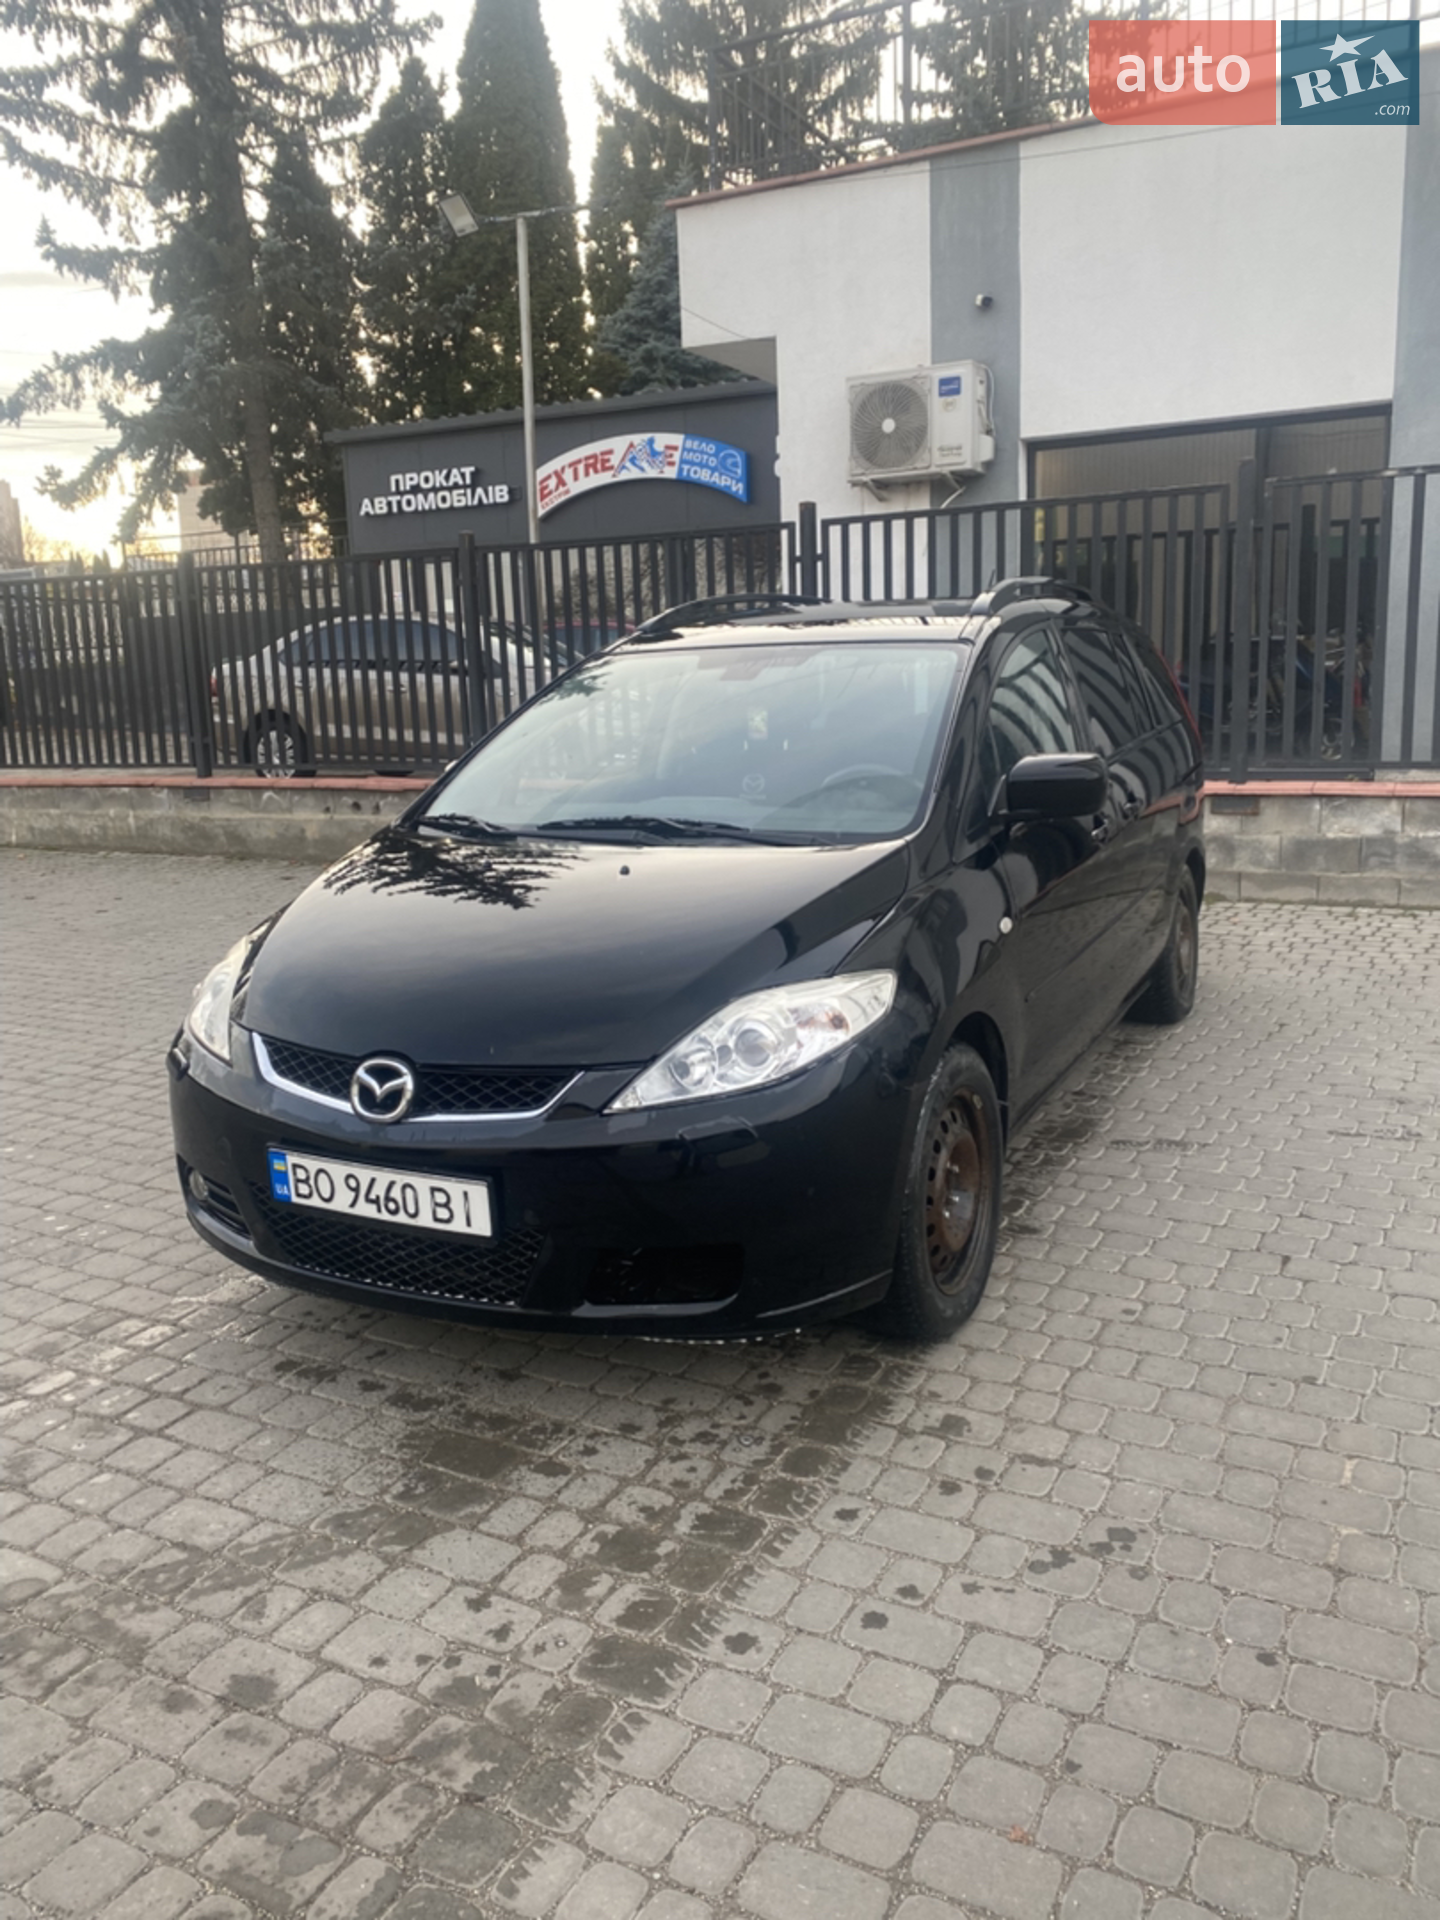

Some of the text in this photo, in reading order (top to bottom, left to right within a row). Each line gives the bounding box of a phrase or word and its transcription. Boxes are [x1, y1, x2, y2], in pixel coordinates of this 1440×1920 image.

[682, 452, 718, 467] МОТО
[684, 439, 715, 453] ВЕЛО
[390, 465, 475, 493] ПРОКАТ
[681, 464, 744, 495] ТОВАРИ
[359, 484, 509, 516] АВТОМОБІЛІВ
[275, 1183, 290, 1196] UA
[291, 1162, 472, 1228] BO 9460 BI
